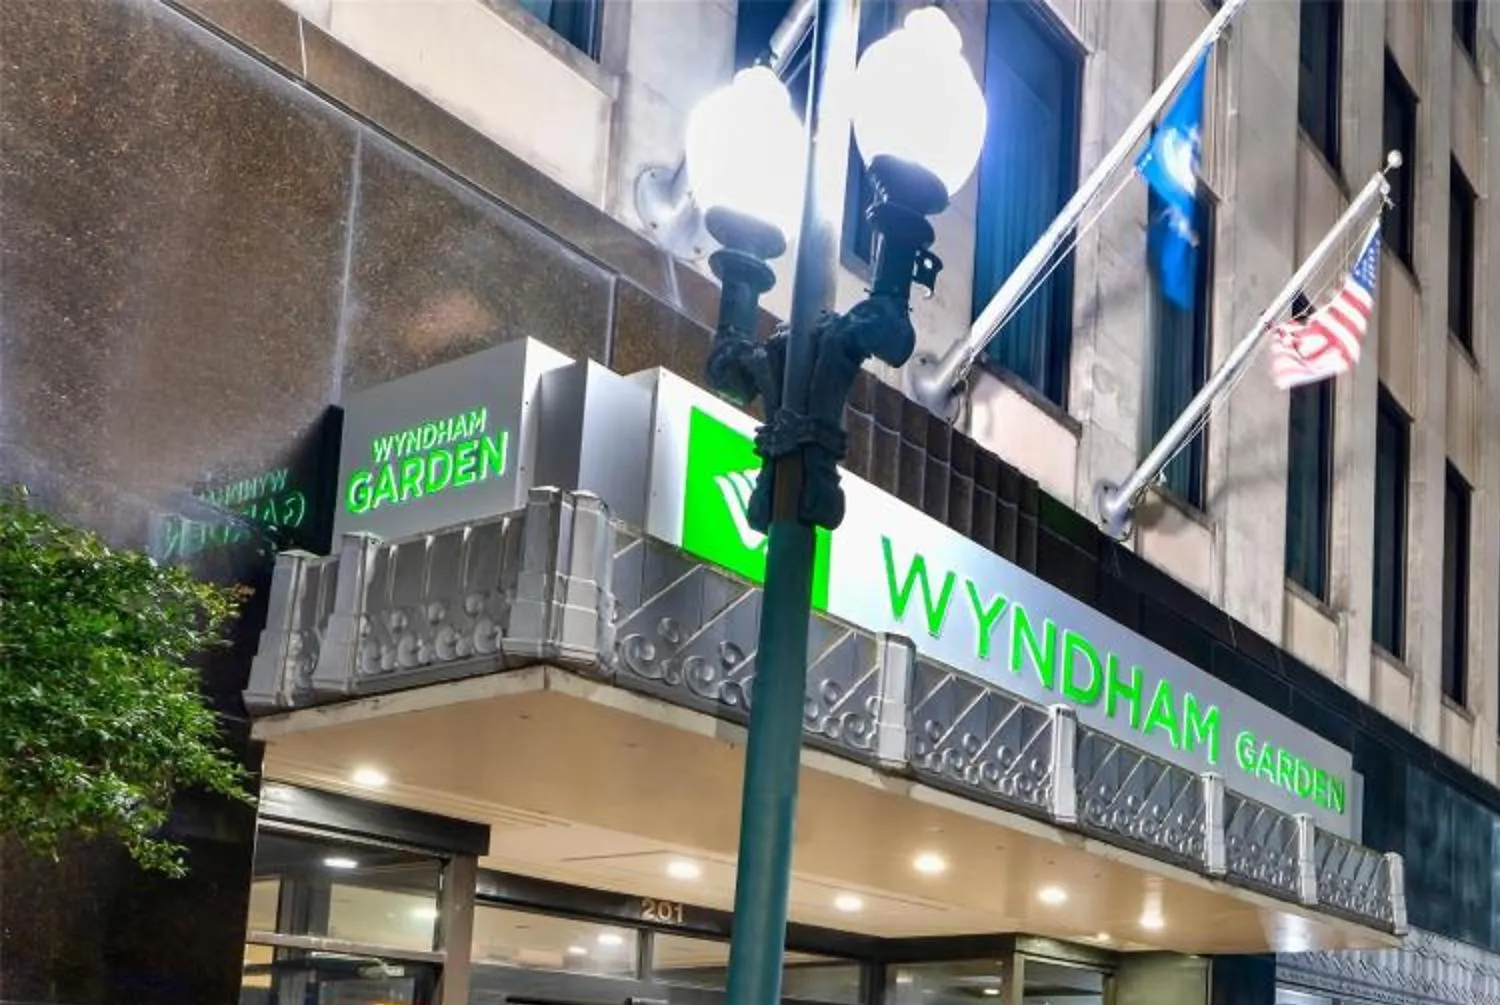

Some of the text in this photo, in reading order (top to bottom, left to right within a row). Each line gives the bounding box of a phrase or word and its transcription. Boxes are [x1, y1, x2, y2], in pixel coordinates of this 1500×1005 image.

[373, 406, 487, 463] WYNDHAM
[346, 431, 509, 513] GARDEN
[881, 534, 1346, 816] WYNDHAM GARDEN
[640, 897, 683, 924] 201
